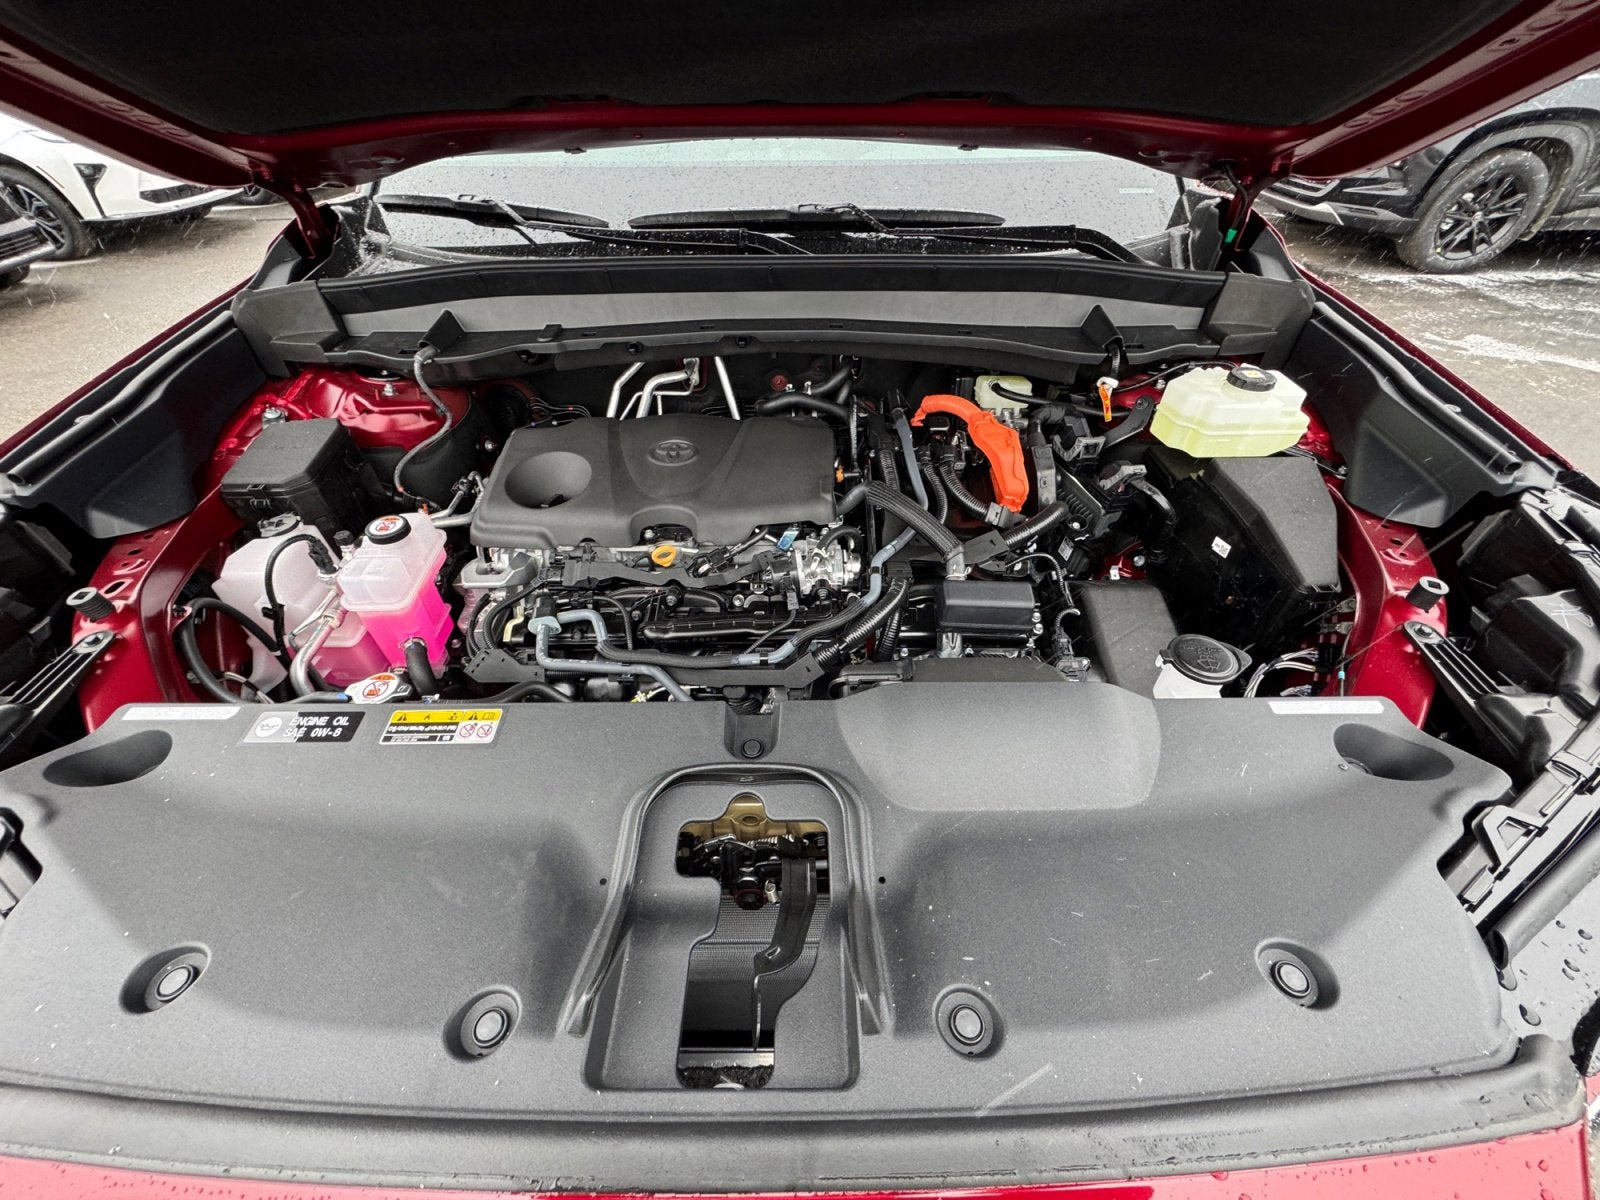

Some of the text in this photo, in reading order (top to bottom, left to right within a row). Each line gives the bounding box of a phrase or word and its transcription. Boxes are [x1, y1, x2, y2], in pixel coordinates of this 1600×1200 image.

[289, 716, 350, 726] ENGINE OIL
[282, 727, 343, 738] SAE 0W-8
